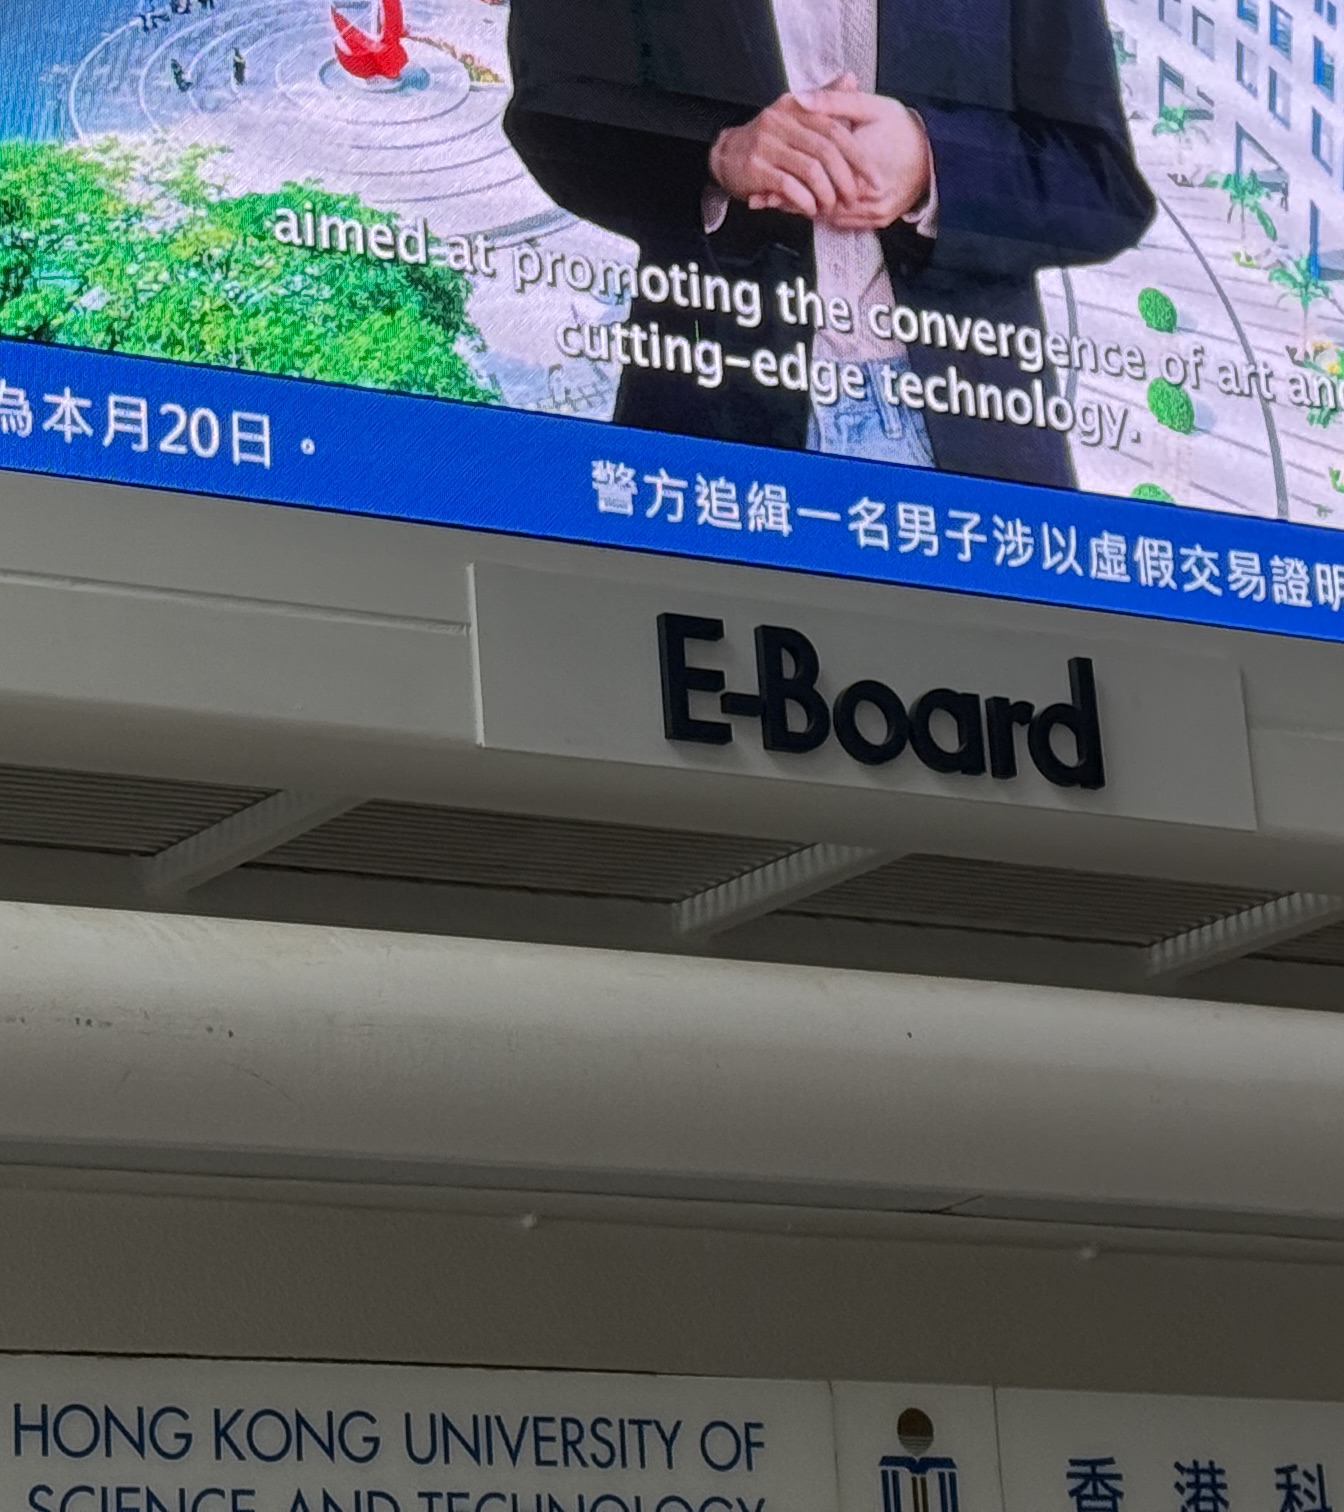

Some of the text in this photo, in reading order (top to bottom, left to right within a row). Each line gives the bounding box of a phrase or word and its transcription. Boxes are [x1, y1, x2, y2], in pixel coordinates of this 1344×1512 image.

[272, 200, 429, 266] aimed
[447, 231, 496, 277] at
[513, 240, 762, 327] promoting
[775, 276, 853, 332] the
[867, 302, 1147, 380] convergence
[1162, 343, 1203, 387] of
[1217, 359, 1277, 401] art
[558, 322, 1143, 450] cutting-edge technology.
[656, 611, 1106, 791] E-Board
[12, 1401, 194, 1462] HONG
[213, 1407, 383, 1465] KONG
[405, 1410, 683, 1471] UNIVERSITY
[700, 1419, 767, 1473] OF
